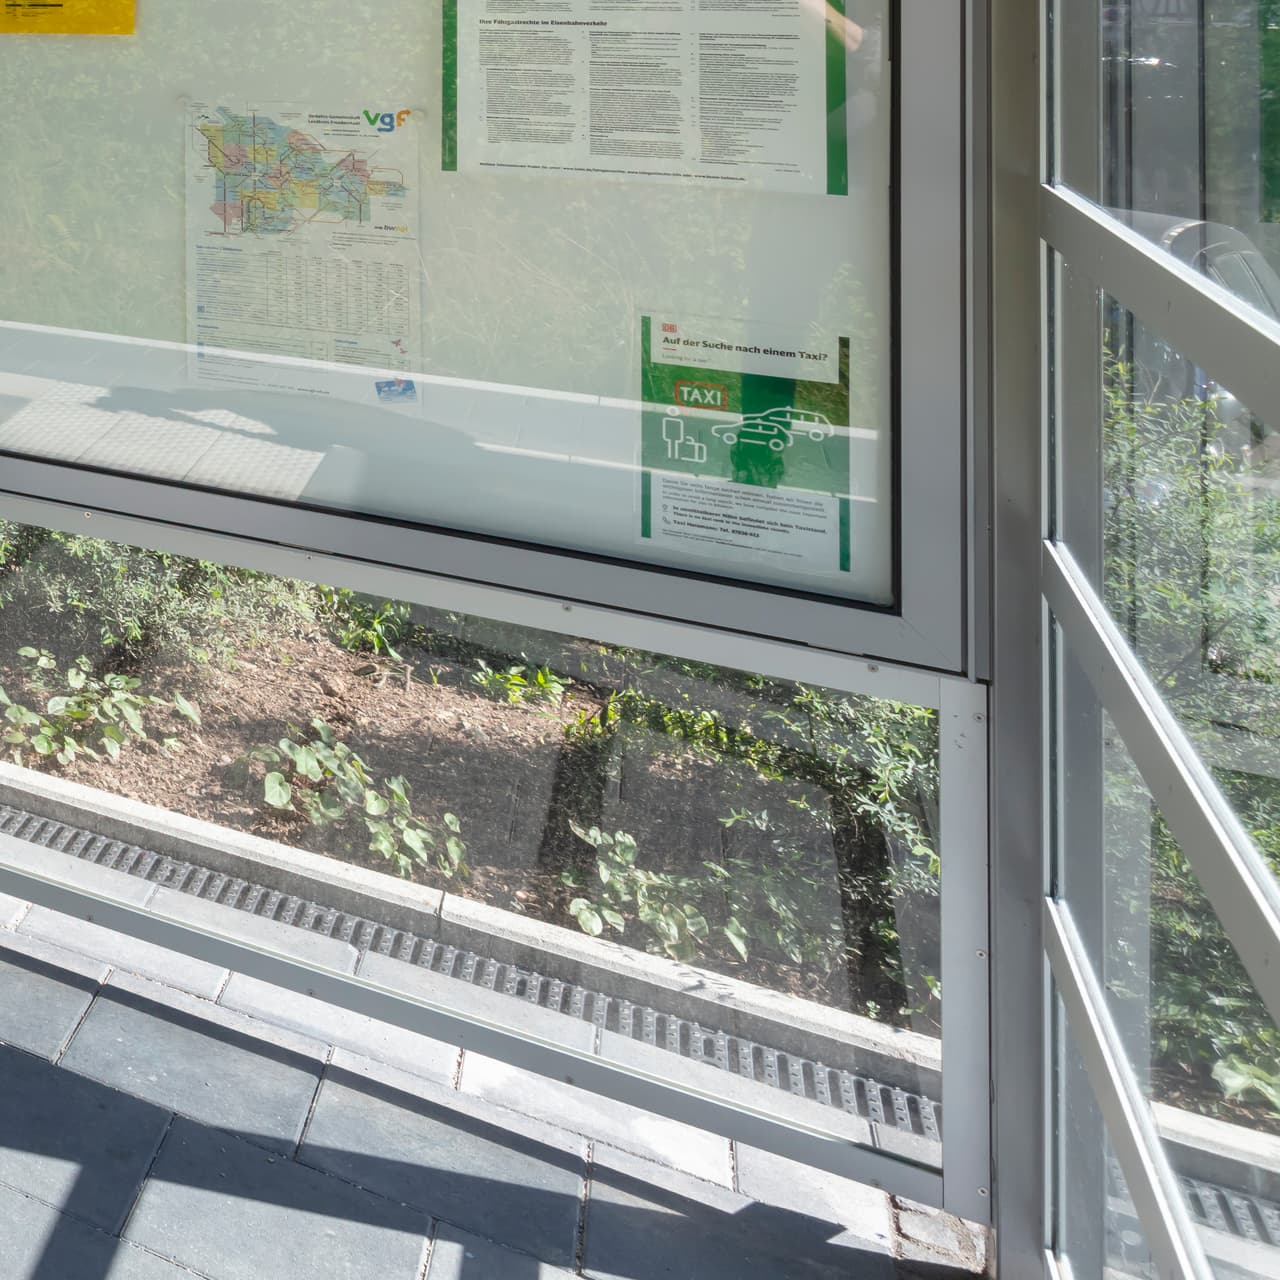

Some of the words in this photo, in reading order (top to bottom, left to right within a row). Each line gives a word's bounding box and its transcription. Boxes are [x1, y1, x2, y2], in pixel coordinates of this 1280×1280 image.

[363, 109, 412, 132] vgf
[662, 336, 681, 345] Auf
[683, 339, 700, 347] der
[702, 340, 734, 351] Suche
[735, 345, 760, 354] nach
[762, 347, 796, 358] einem
[798, 351, 829, 361] Taxi?
[679, 386, 721, 406] TAXI
